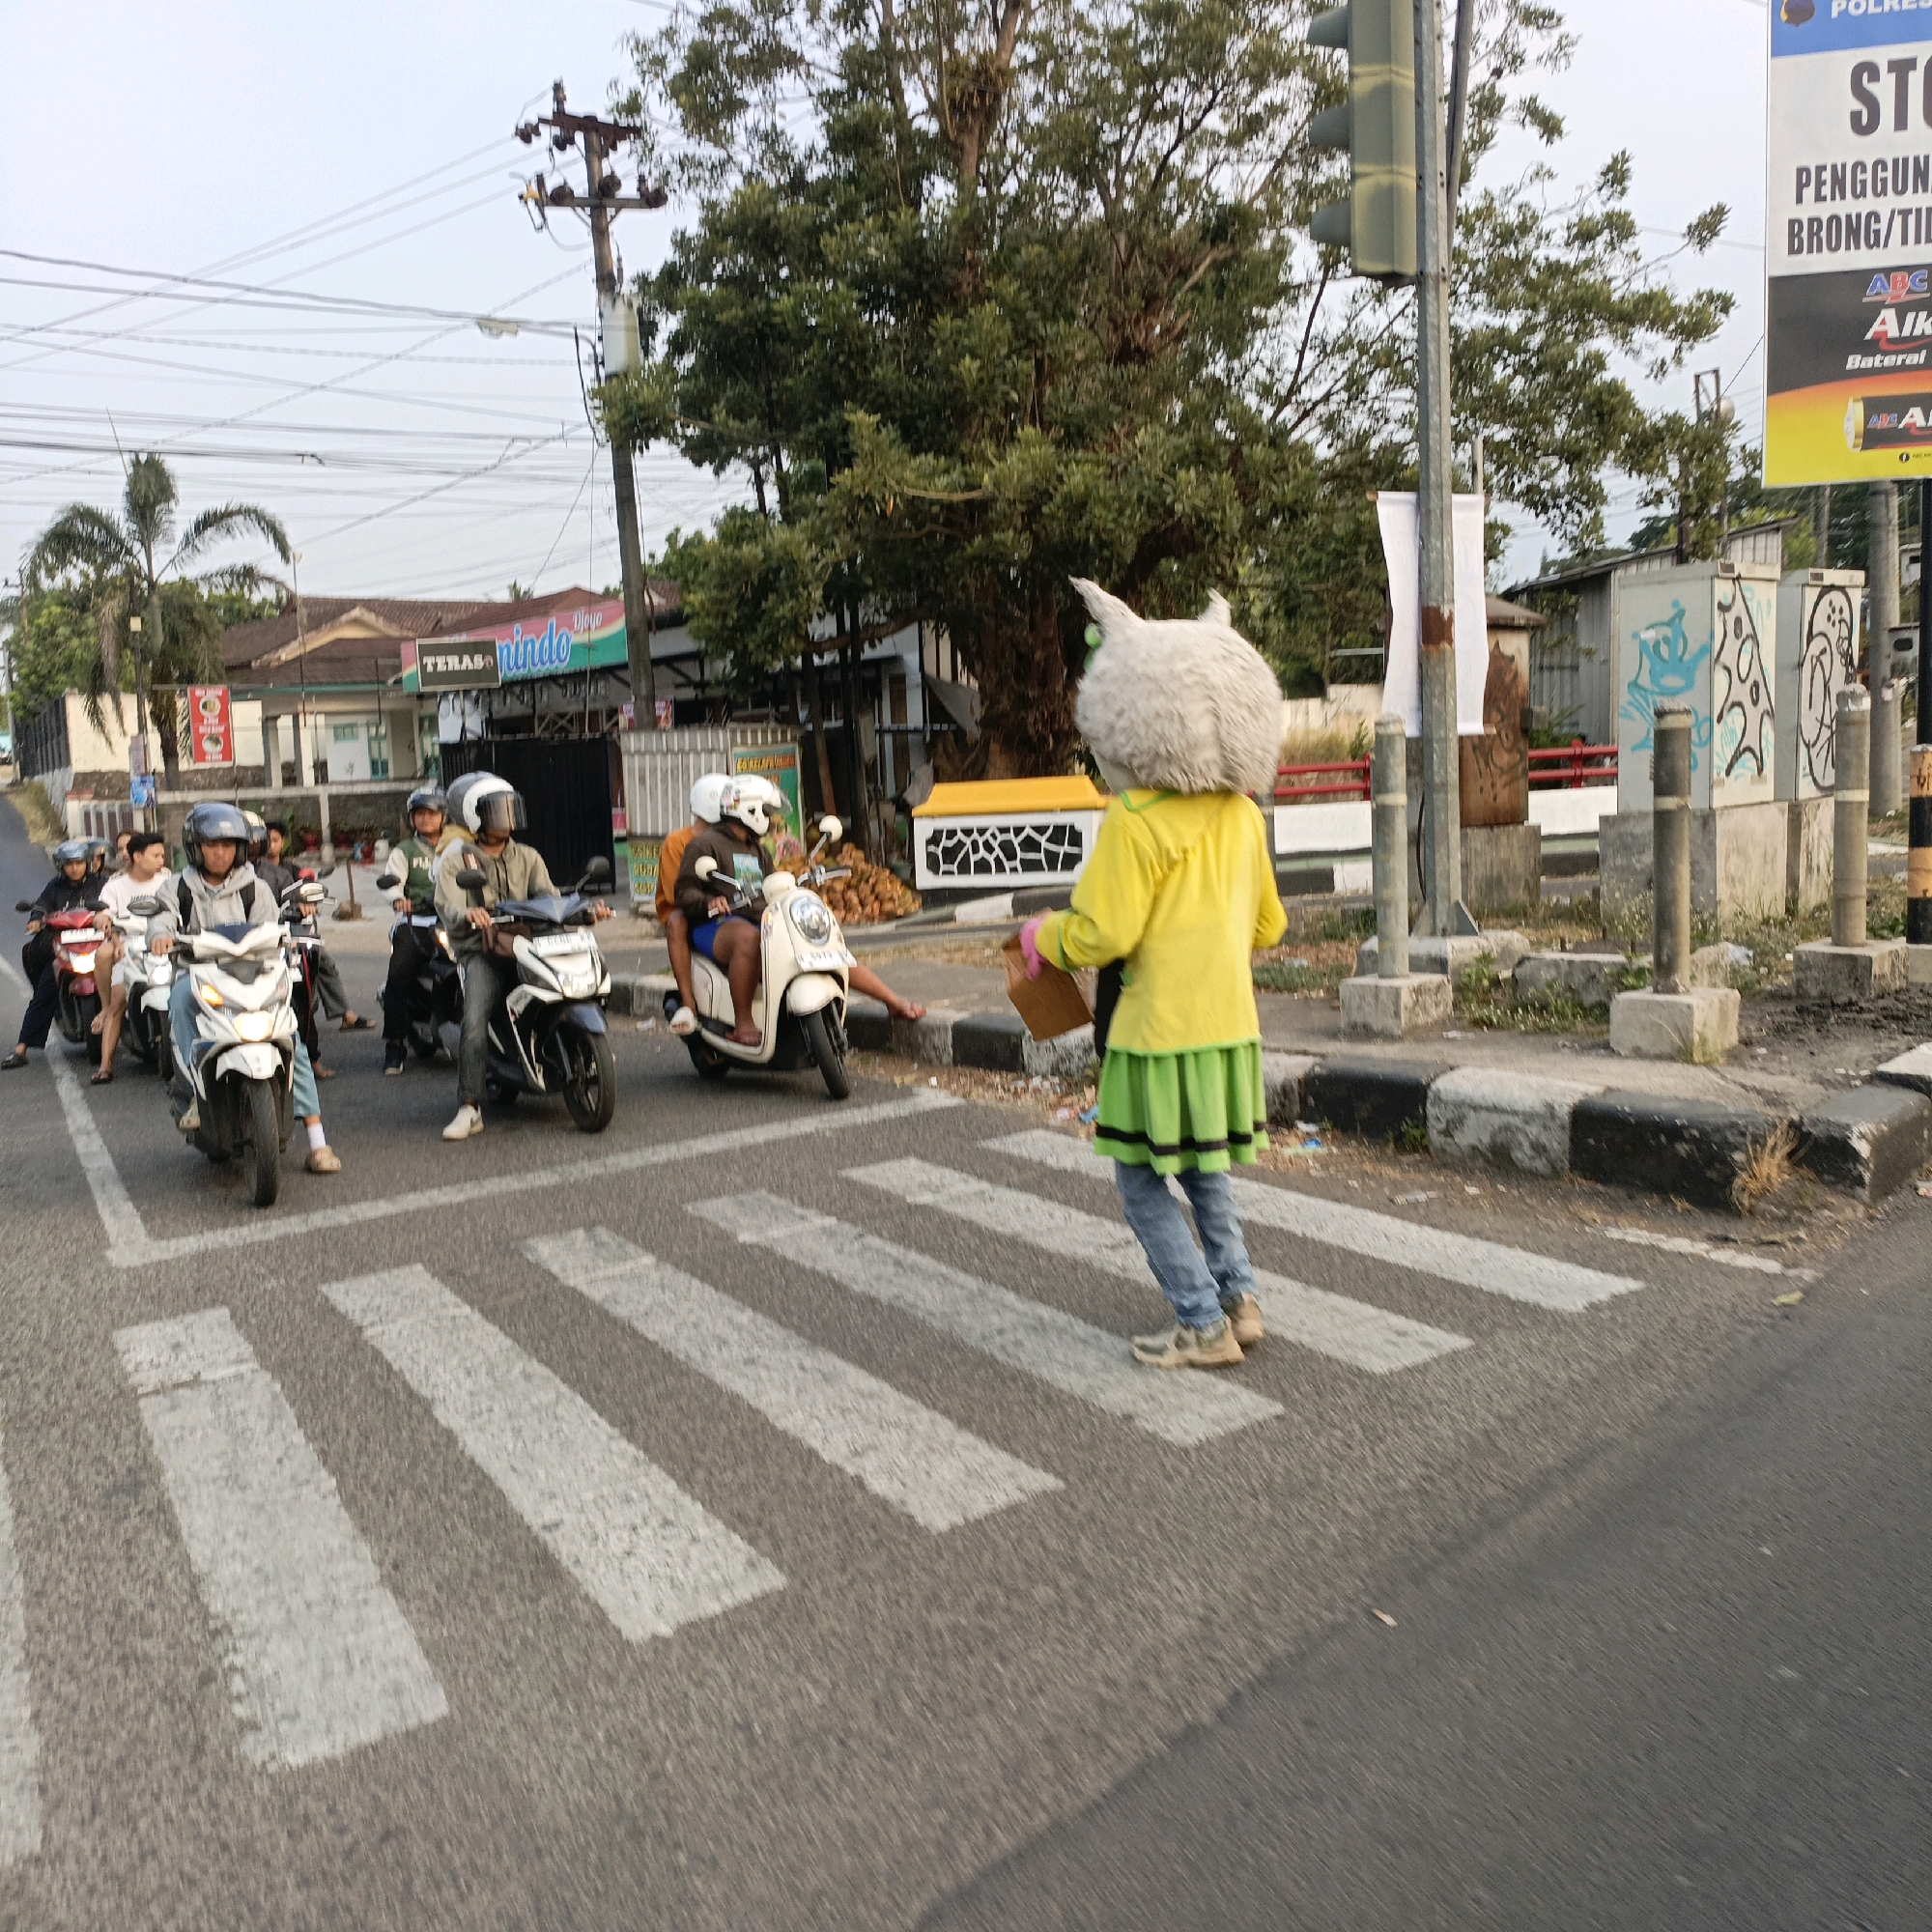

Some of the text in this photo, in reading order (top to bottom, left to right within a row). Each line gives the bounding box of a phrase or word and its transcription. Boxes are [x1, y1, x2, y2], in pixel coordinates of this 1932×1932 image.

[1865, 270, 1929, 302] ABC
[1868, 412, 1898, 428] ABC
[422, 653, 484, 673] TERAS
